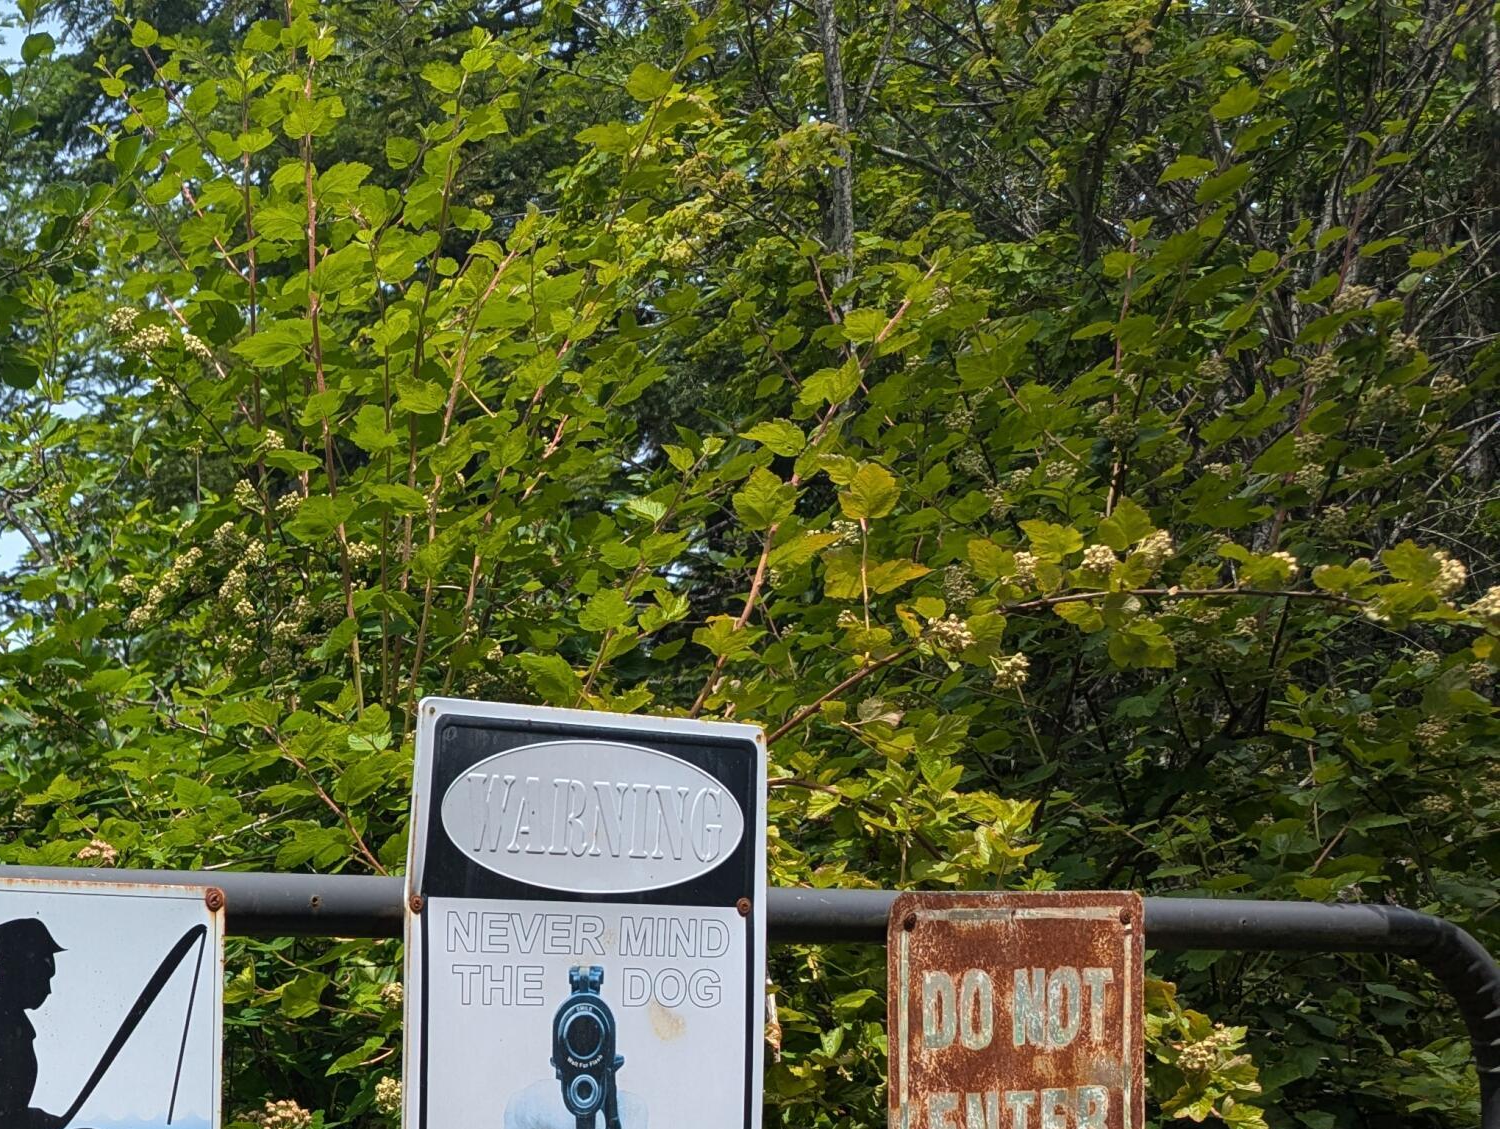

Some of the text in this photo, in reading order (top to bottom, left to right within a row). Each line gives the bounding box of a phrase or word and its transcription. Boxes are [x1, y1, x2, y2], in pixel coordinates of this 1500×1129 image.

[466, 773, 724, 863] WARNING
[446, 911, 730, 958] NEVER MIND
[452, 964, 722, 1009] THE DOG
[922, 966, 1114, 1051] DO NOT
